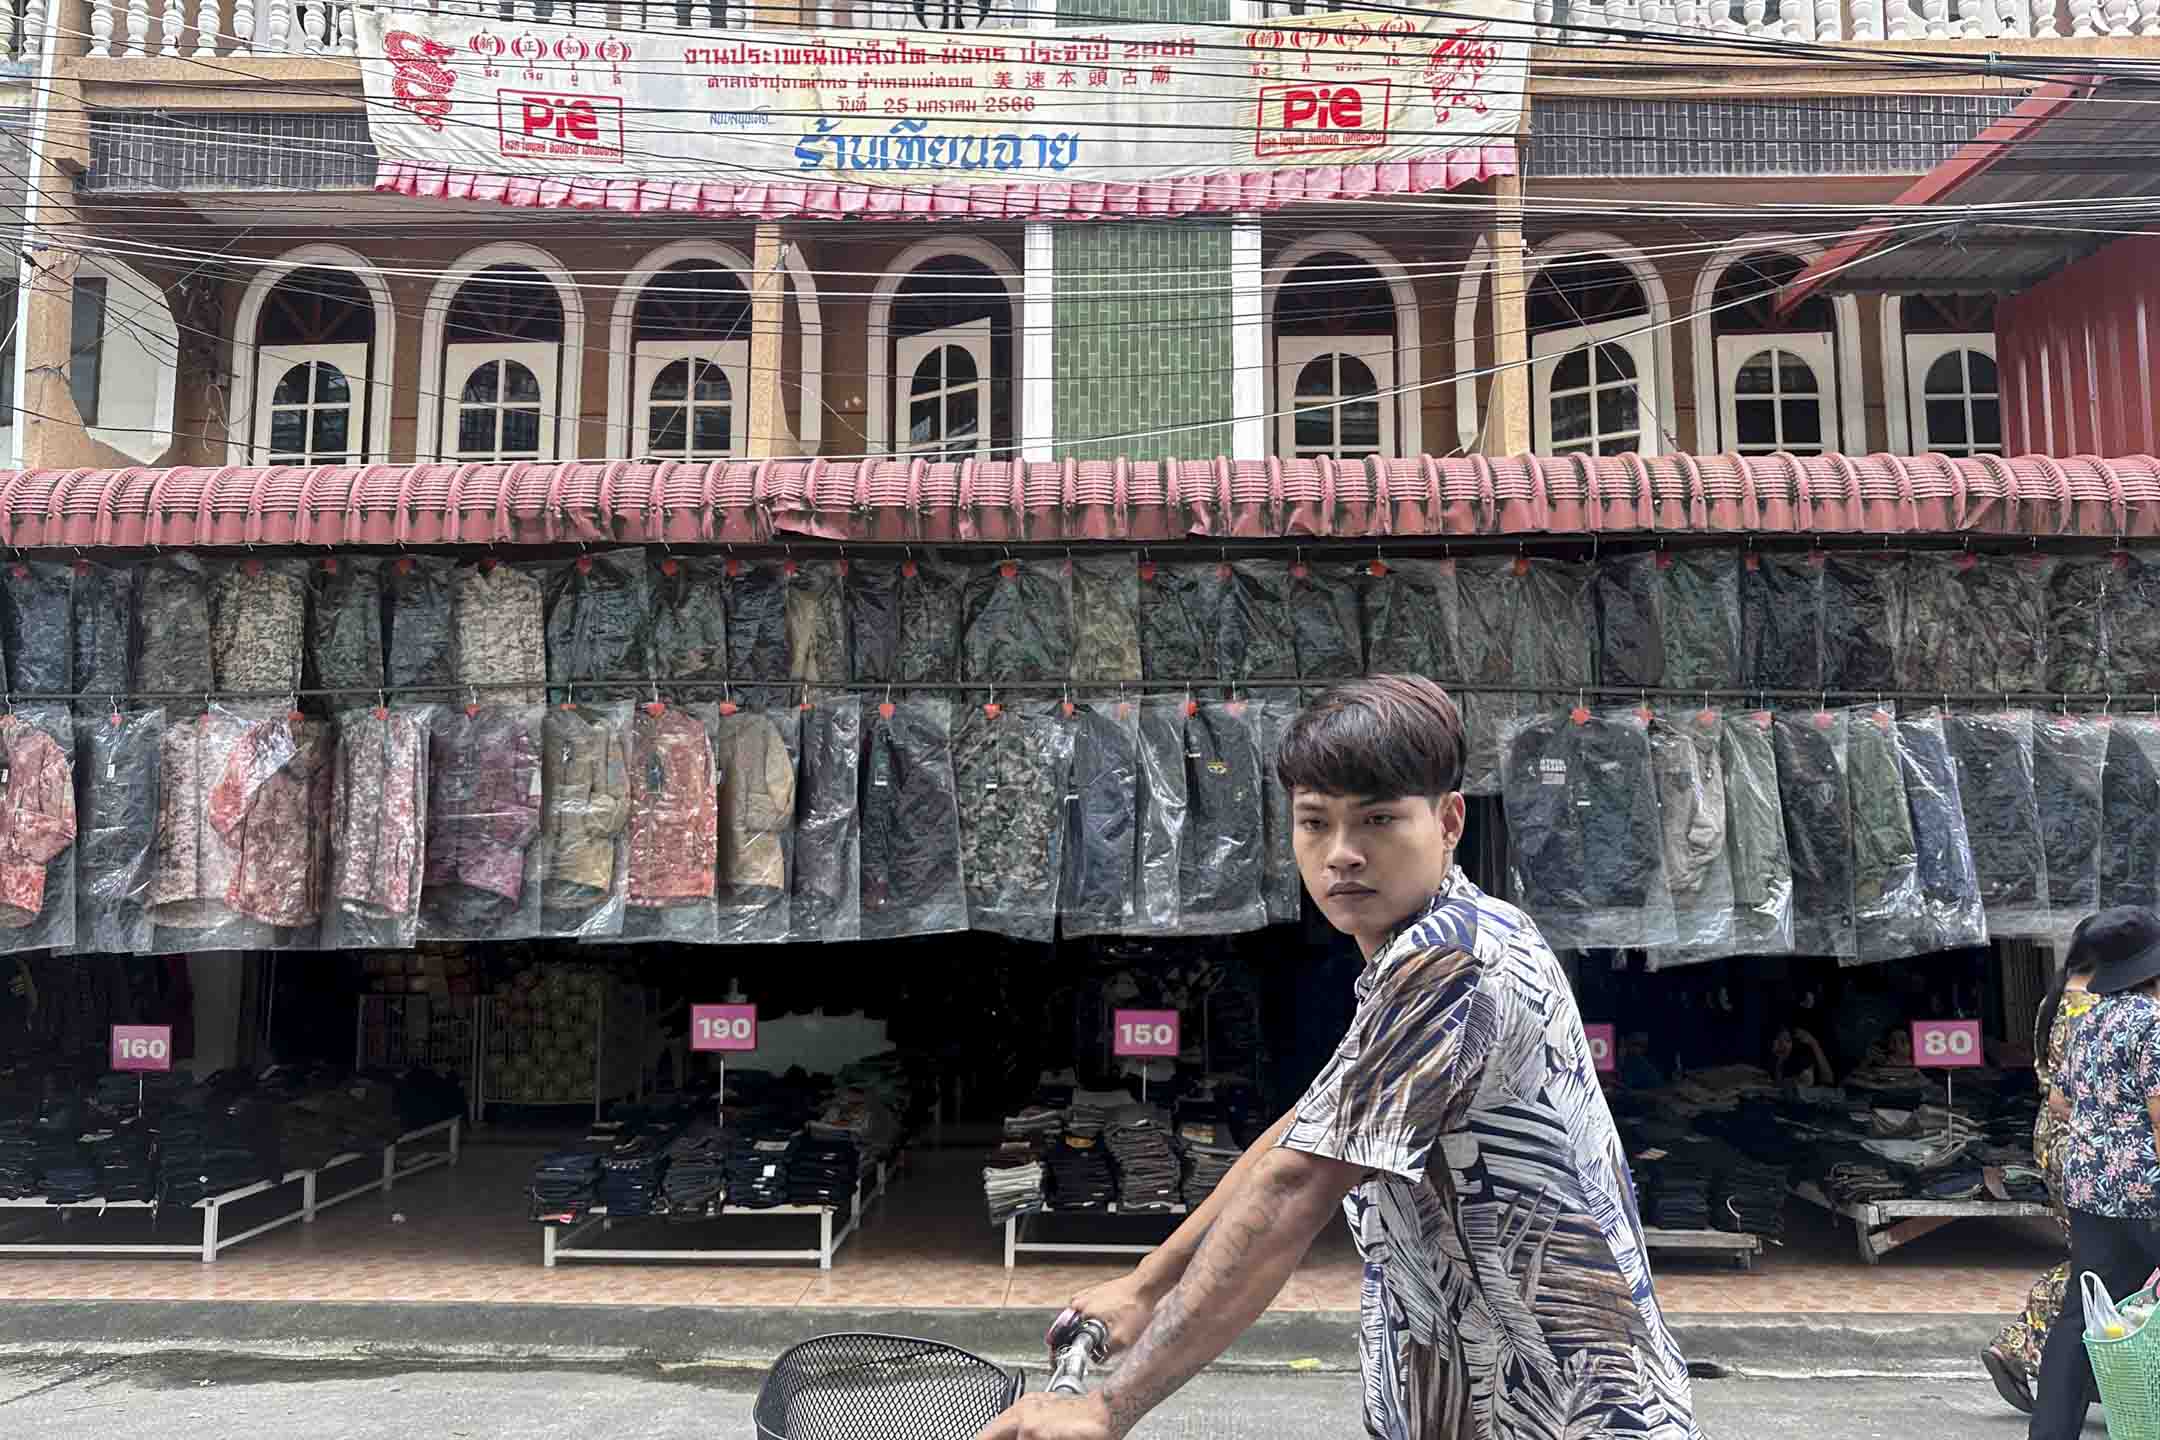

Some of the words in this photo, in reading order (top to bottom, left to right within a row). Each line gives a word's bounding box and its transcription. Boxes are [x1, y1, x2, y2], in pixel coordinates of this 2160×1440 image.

[883, 98, 909, 113] 25
[916, 99, 977, 113] มกราคม
[984, 96, 1036, 113] 2566
[793, 118, 1080, 172] ร้านเทียนฉาย
[697, 1018, 751, 1039] 190
[1119, 1023, 1173, 1045] 150
[119, 1039, 167, 1058] 160
[1924, 1030, 1973, 1056] 80
